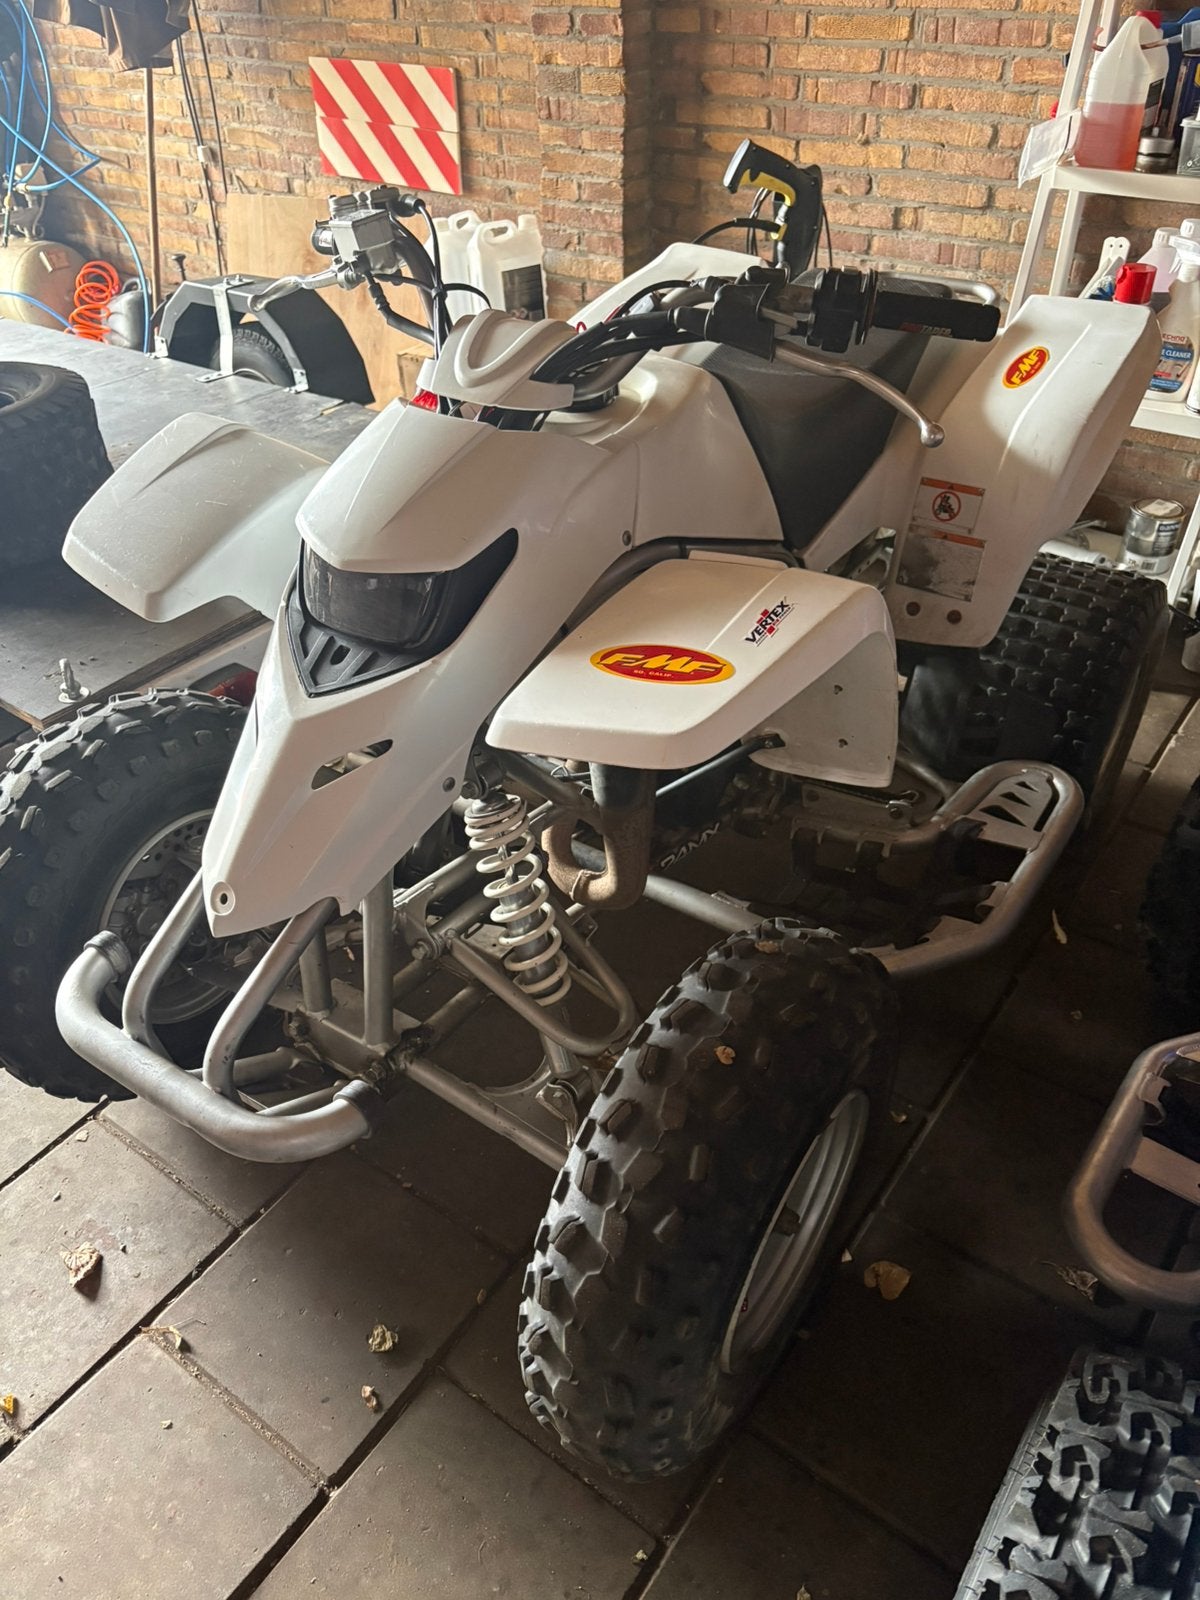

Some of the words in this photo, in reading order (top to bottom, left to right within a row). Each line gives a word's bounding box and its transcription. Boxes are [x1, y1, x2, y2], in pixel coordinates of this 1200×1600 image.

[1161, 333, 1186, 342] ECHNO
[1165, 349, 1192, 359] CLEANER
[1010, 349, 1040, 385] FMF
[744, 600, 790, 643] VERTEX
[598, 652, 725, 674] FMF
